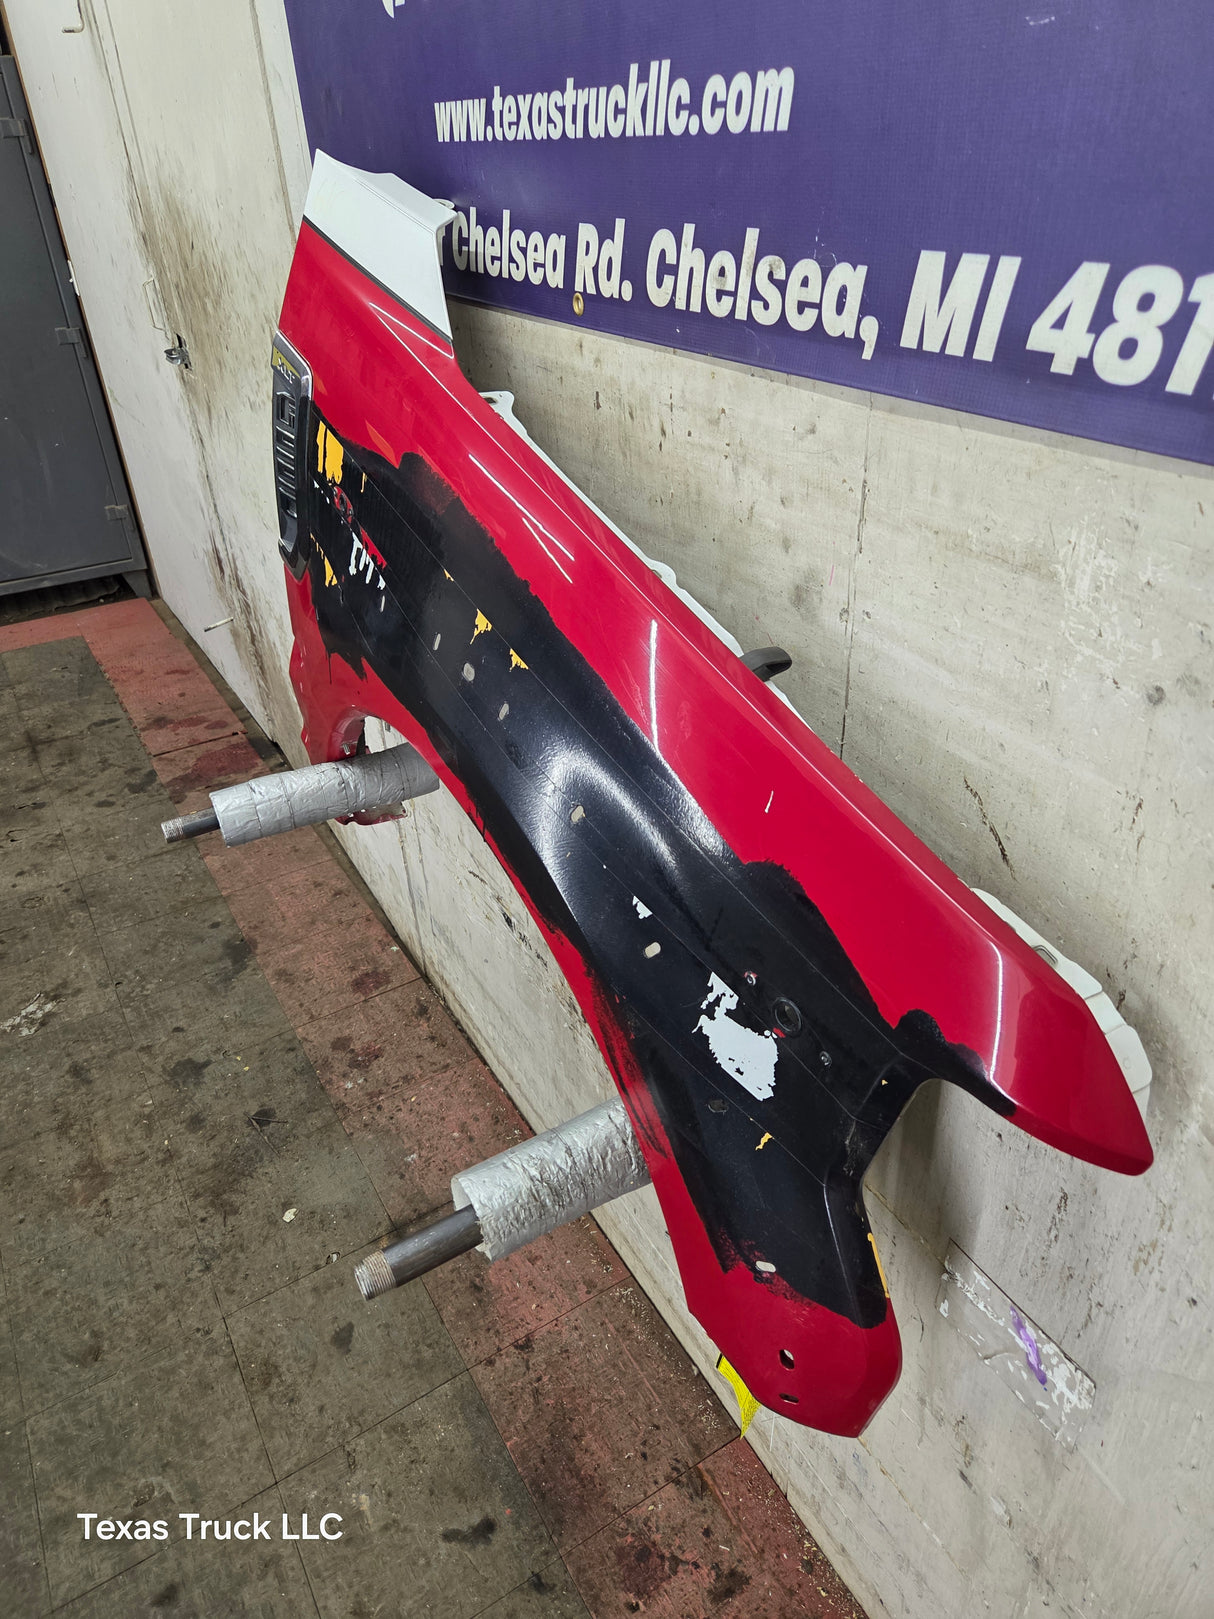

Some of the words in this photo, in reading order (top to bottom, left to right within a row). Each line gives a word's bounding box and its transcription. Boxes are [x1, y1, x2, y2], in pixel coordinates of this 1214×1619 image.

[433, 58, 795, 143] www.texastruckllc.com
[452, 206, 567, 289] Chelsea
[574, 218, 633, 302] Rd.
[646, 223, 879, 361] Chelsea,
[899, 250, 1022, 362] MI
[276, 357, 296, 384] XLT
